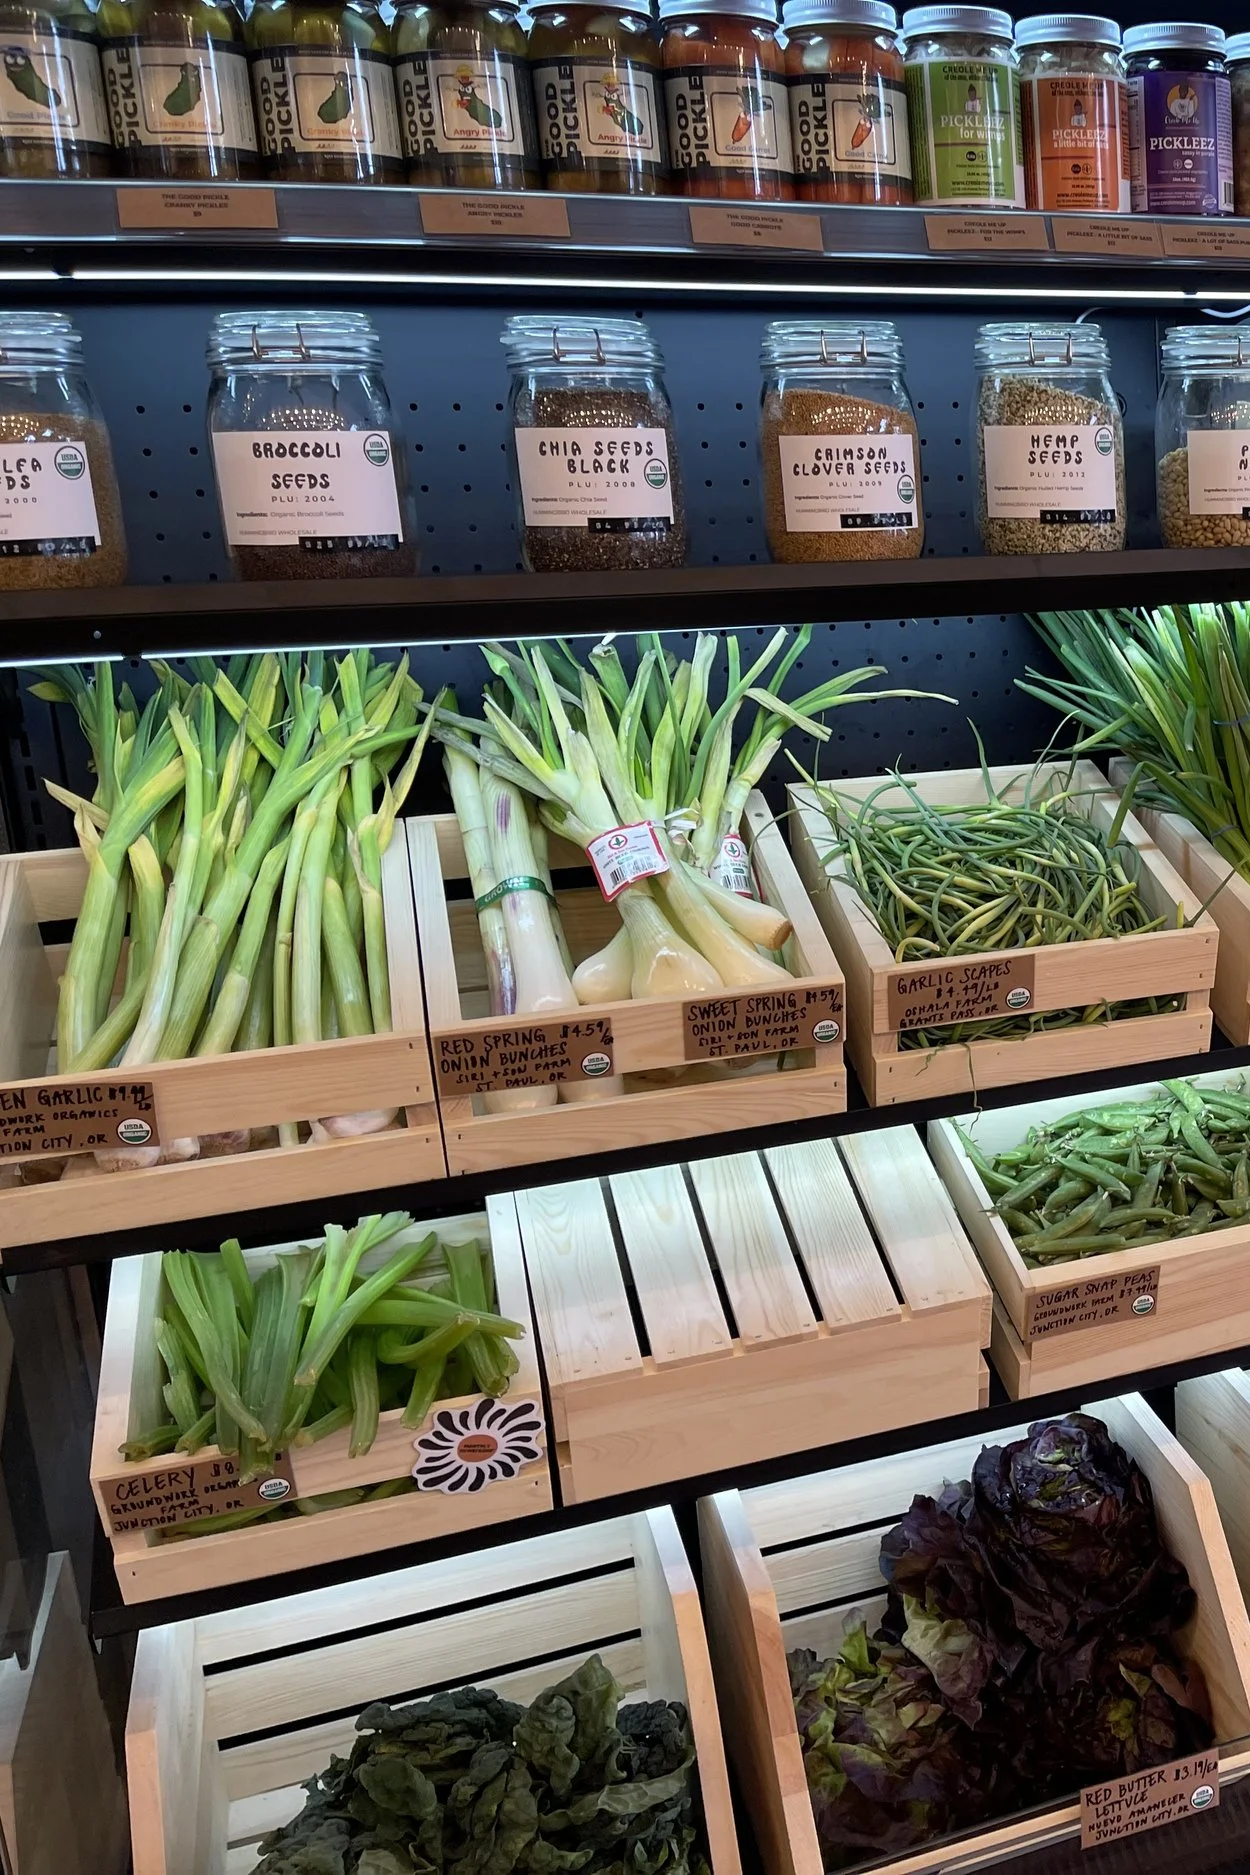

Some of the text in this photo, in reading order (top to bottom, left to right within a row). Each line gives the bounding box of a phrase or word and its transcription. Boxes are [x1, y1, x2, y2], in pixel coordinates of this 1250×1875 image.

[116, 46, 143, 149] PICKLE
[271, 57, 296, 153] PICKLE
[413, 59, 439, 153] PICKLE
[545, 82, 563, 160] GOOD
[559, 65, 583, 159] PICKLE
[689, 75, 711, 167] PICKLE
[453, 128, 480, 138] Angry
[598, 133, 624, 144] Angry
[677, 93, 694, 168] GOOD
[798, 99, 814, 173] GOOD
[811, 82, 831, 174] PICKLE
[960, 128, 974, 139] for
[1150, 136, 1215, 151] PICKLEEZ
[252, 442, 341, 459] BROCCOLI
[538, 440, 654, 457] CHIA SEEDS
[814, 447, 887, 461] CRIMSON
[1030, 434, 1079, 449] HEMP
[61, 453, 78, 462] USDA
[567, 458, 630, 474] BLACK
[793, 461, 906, 476] CLOVER SEEDS
[1028, 450, 1083, 465] SEEDS
[271, 473, 330, 490] SEEDS
[304, 495, 335, 503] 2004
[897, 960, 1012, 996] GARLIC SCAPES
[687, 992, 797, 1022] SWEET SPRING
[899, 1003, 999, 1029] GRANTS OR
[905, 994, 992, 1018] OSHALA FARM
[691, 1007, 807, 1038] ONION BUNCHES
[698, 1024, 800, 1047] SIRI SON FARM
[440, 1027, 546, 1057] RED SPRING
[781, 1036, 799, 1047] OR
[440, 1040, 568, 1074] ONION BUNCHES
[455, 1057, 571, 1085] SIRI SON FARM
[548, 1071, 568, 1082] OR
[37, 1086, 104, 1108] GARLIC
[52, 1109, 120, 1121] ORGANICS
[123, 1123, 144, 1131] USDA
[2, 1125, 46, 1137] FARM
[87, 1133, 108, 1145] OR
[1036, 1270, 1156, 1309] SUGAR SNAP PEAS
[1029, 1305, 1120, 1336] JUNCTION OR
[1033, 1294, 1115, 1322] GROUNDWORK FARM
[115, 1466, 196, 1501] CELERY
[264, 1480, 284, 1490] USDA
[110, 1488, 199, 1515] GROUNDWORK
[160, 1498, 200, 1515] FARM
[112, 1499, 245, 1532] JUNCTION OR
[1085, 1769, 1168, 1808] RED BUTTER
[1087, 1793, 1186, 1833] NUEVO AMANECER
[1095, 1788, 1149, 1820] LETTUCE
[1095, 1804, 1190, 1841] JUNCTION OR
